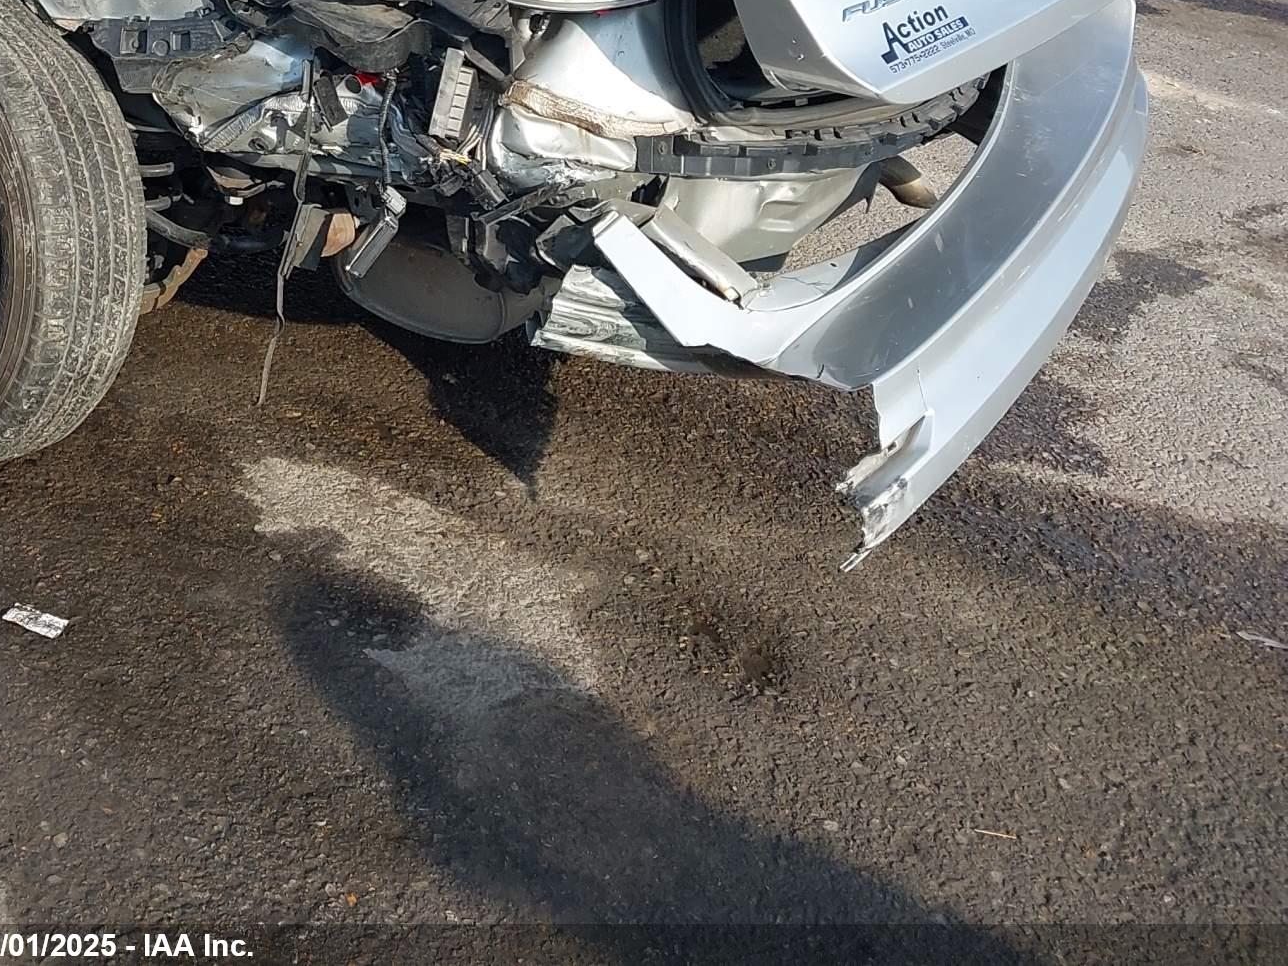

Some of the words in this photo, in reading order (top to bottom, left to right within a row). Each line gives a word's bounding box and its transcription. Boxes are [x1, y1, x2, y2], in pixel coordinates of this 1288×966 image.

[881, 5, 949, 63] Action
[907, 32, 935, 52] AUTO
[935, 18, 963, 41] SALES
